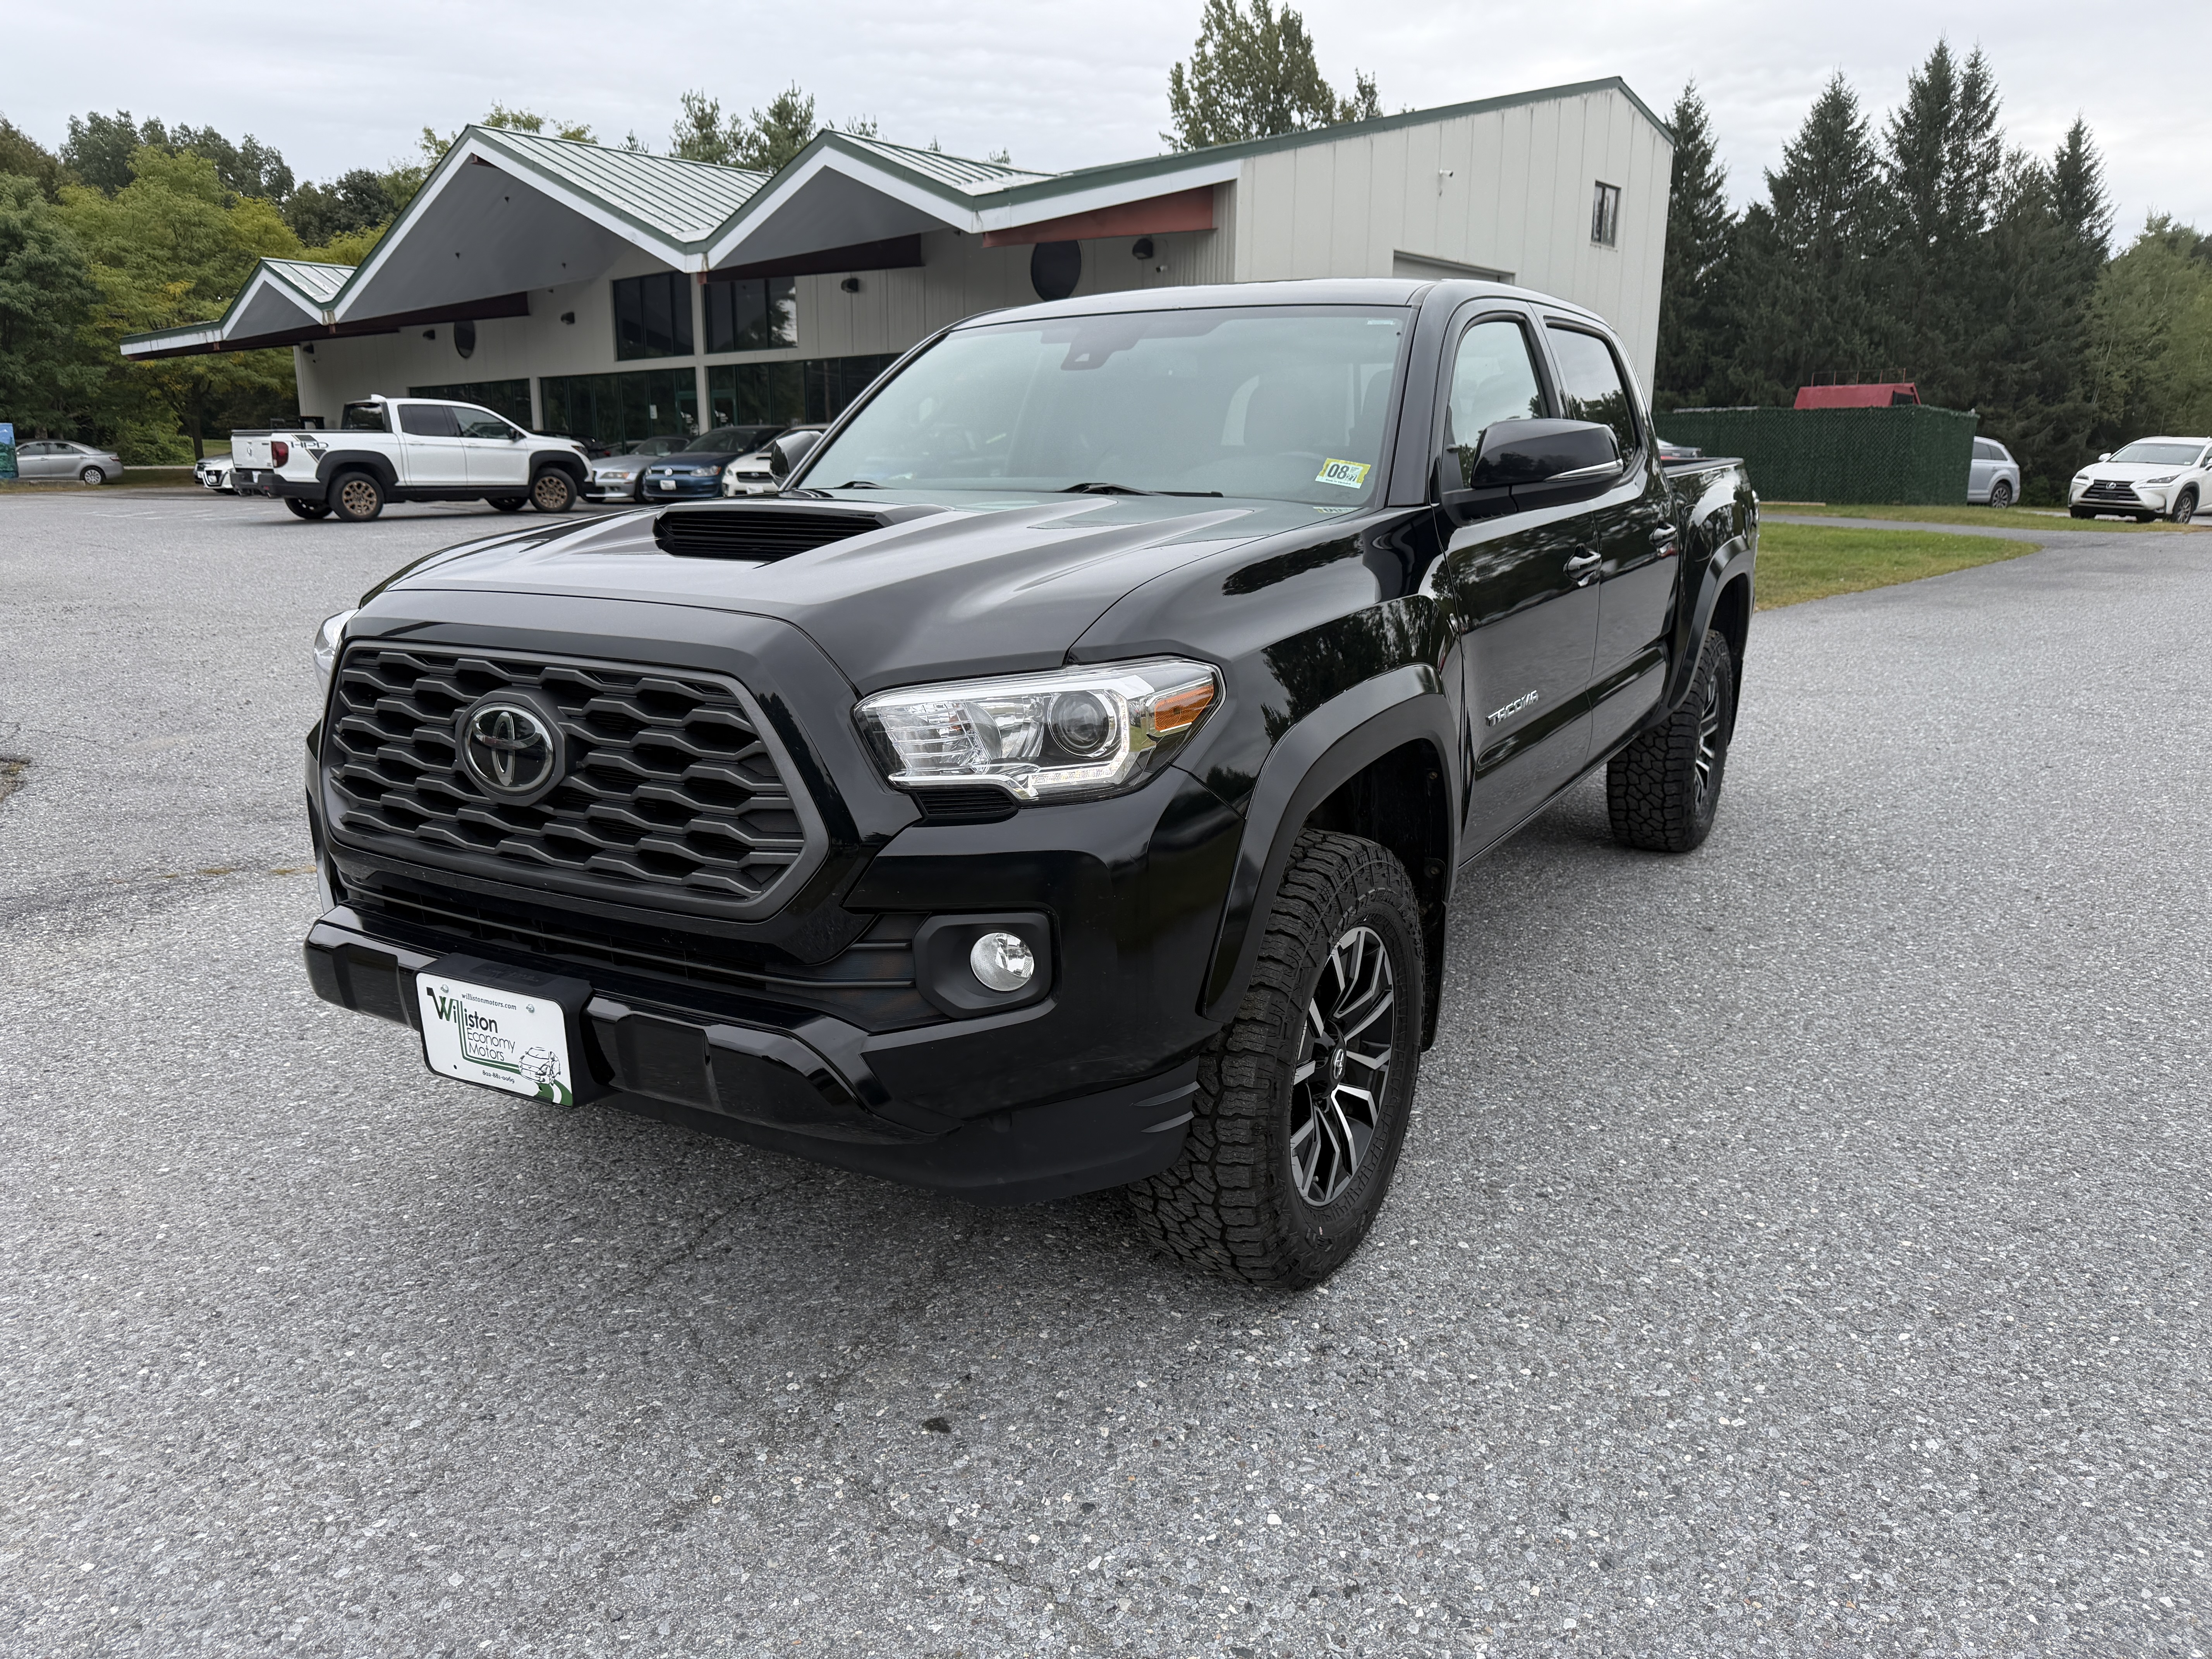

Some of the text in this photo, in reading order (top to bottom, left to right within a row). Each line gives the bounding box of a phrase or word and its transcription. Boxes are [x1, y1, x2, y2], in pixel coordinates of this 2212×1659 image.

[1328, 464, 1349, 479] 08
[1485, 690, 1539, 726] TACOMA
[426, 987, 498, 1033] Williston
[462, 993, 517, 1011] willistonmotors.com
[467, 1028, 515, 1053] Economy
[469, 1043, 505, 1061] Motors
[483, 1070, 515, 1083] 802-881-0069
